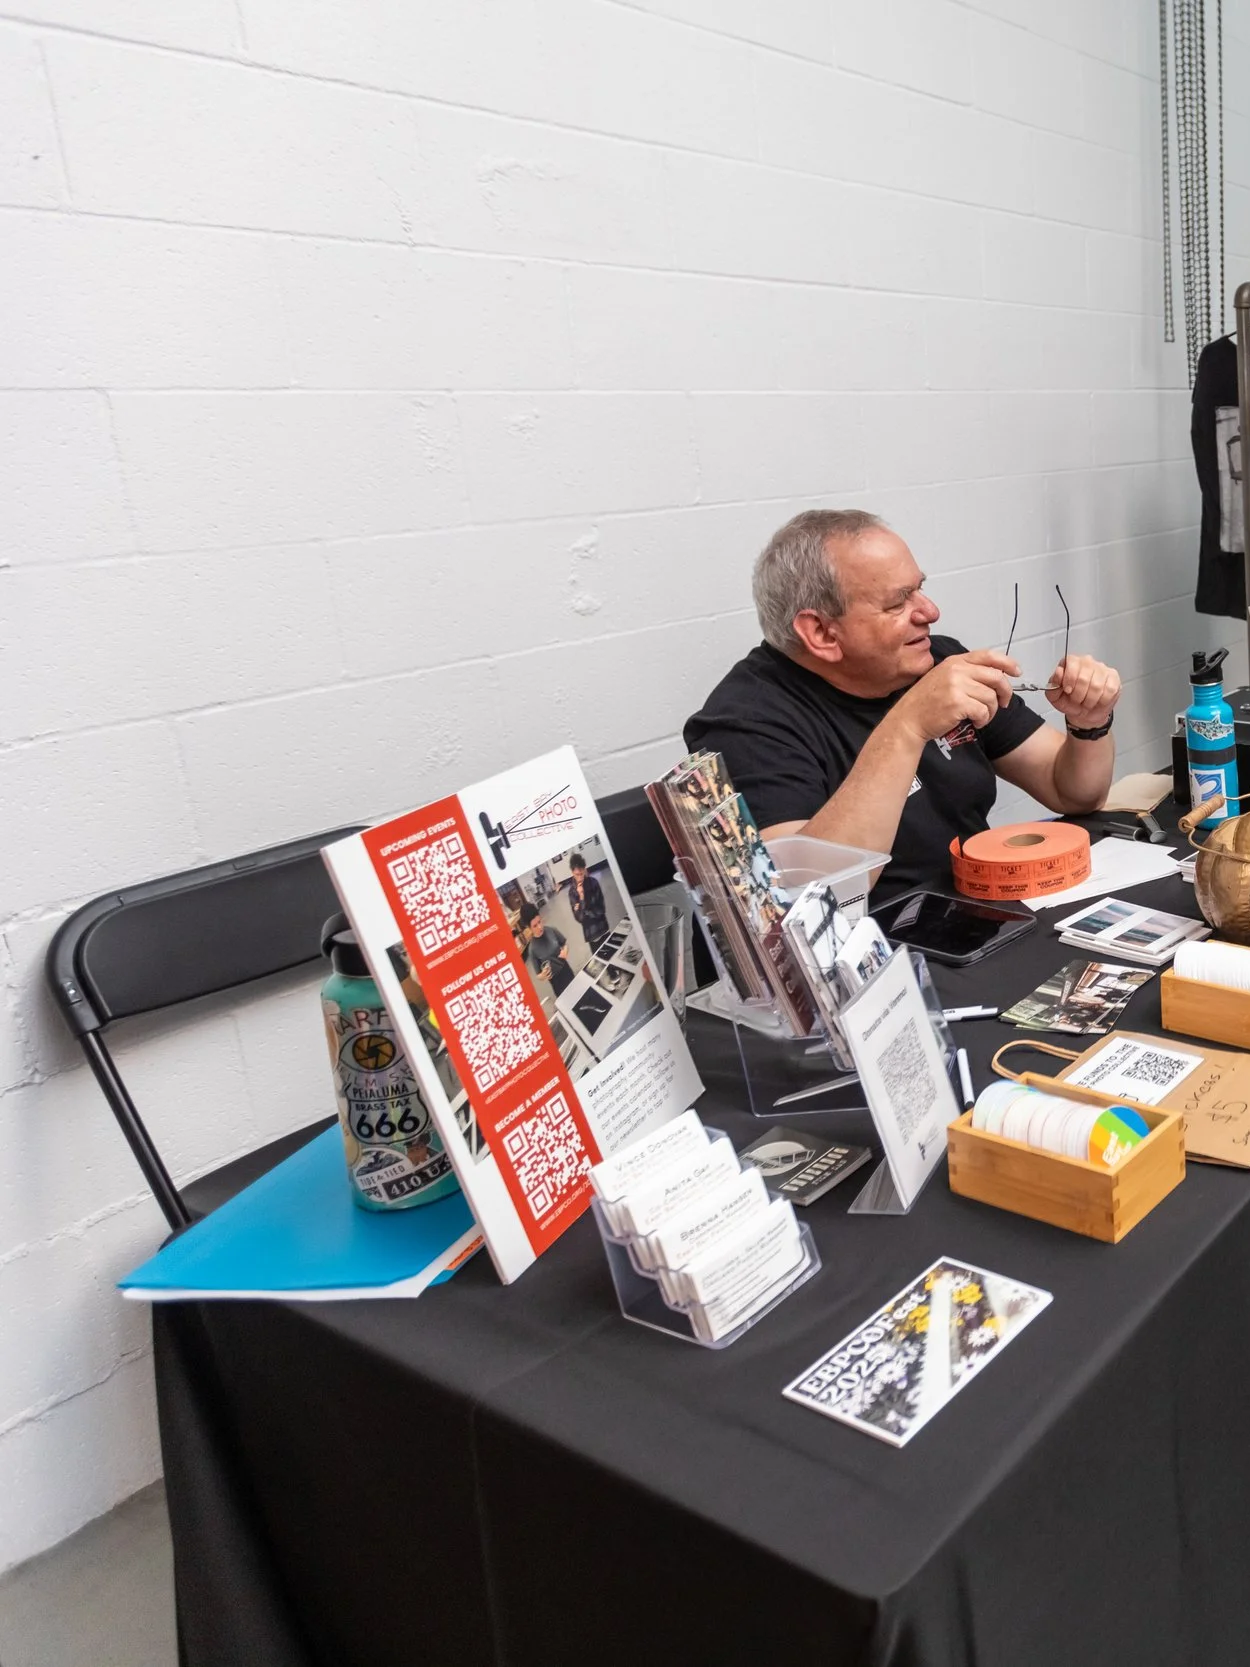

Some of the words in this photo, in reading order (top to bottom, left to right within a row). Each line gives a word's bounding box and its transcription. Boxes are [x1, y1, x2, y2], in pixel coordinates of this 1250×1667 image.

[538, 796, 578, 824] PHOTO
[379, 832, 427, 858] UPCOMING
[427, 816, 457, 836] EVENTS
[509, 821, 575, 843] COLLECTIVE
[1000, 864, 1023, 872] TICKET
[1039, 858, 1060, 869] TICKET
[1039, 881, 1064, 890] COUPON
[1052, 876, 1066, 884] THIS
[441, 973, 473, 997] FOLLOW
[473, 964, 485, 977] US
[484, 958, 498, 971] ON
[496, 951, 508, 964] IG
[1083, 1062, 1109, 1081] FUNDS
[1105, 1054, 1118, 1064] TO
[1114, 1043, 1133, 1055] THE
[587, 1085, 600, 1098] Get
[600, 1061, 626, 1088] involved!
[1090, 1070, 1111, 1086] PHOTO
[352, 1082, 410, 1099] PETALUMA
[355, 1102, 387, 1112] BRASS
[389, 1099, 412, 1109] TAX
[494, 1107, 526, 1133] BECOME
[524, 1098, 533, 1110] A
[531, 1075, 561, 1105] MEMBER
[1206, 1099, 1249, 1125] $5
[356, 1107, 421, 1139] 666
[613, 1148, 646, 1173] VINCE
[359, 1176, 378, 1188] TIDE
[384, 1165, 406, 1179] TIED
[389, 1174, 423, 1197] 410
[661, 1174, 692, 1197] ANITA
[678, 1212, 720, 1241] BRENNA
[801, 1290, 928, 1398] EBPCOFest
